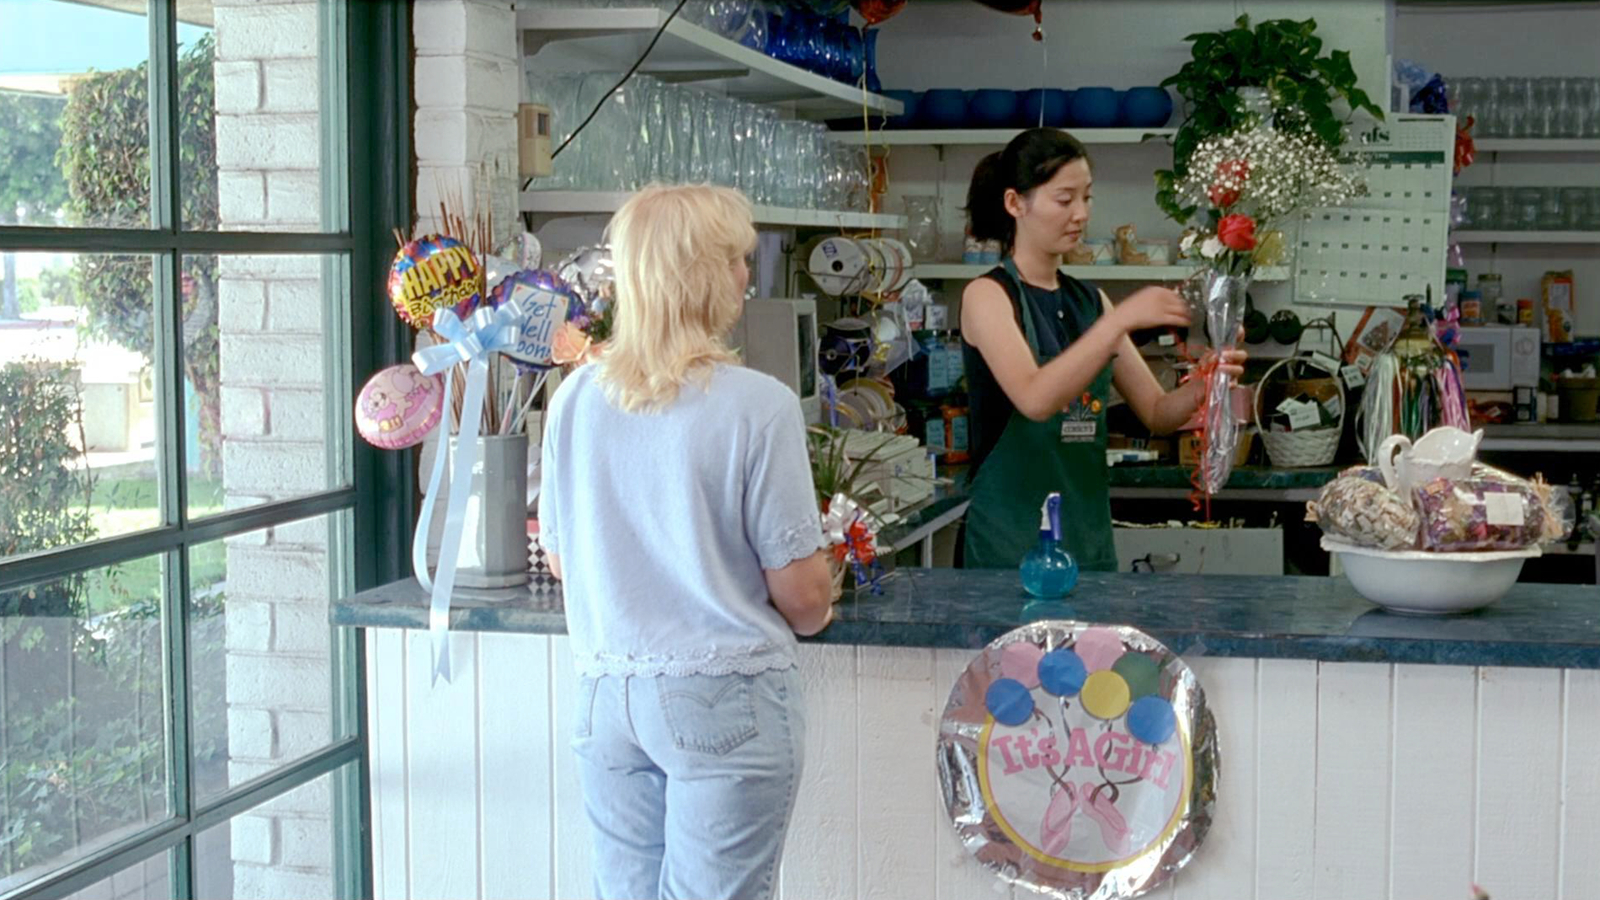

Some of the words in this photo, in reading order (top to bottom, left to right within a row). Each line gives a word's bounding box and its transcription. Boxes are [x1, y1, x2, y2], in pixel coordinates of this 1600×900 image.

[402, 246, 475, 299] HAPPY
[522, 290, 558, 319] Get
[992, 728, 1061, 776] It's
[1064, 727, 1095, 768] A
[1094, 730, 1176, 791] Girl
